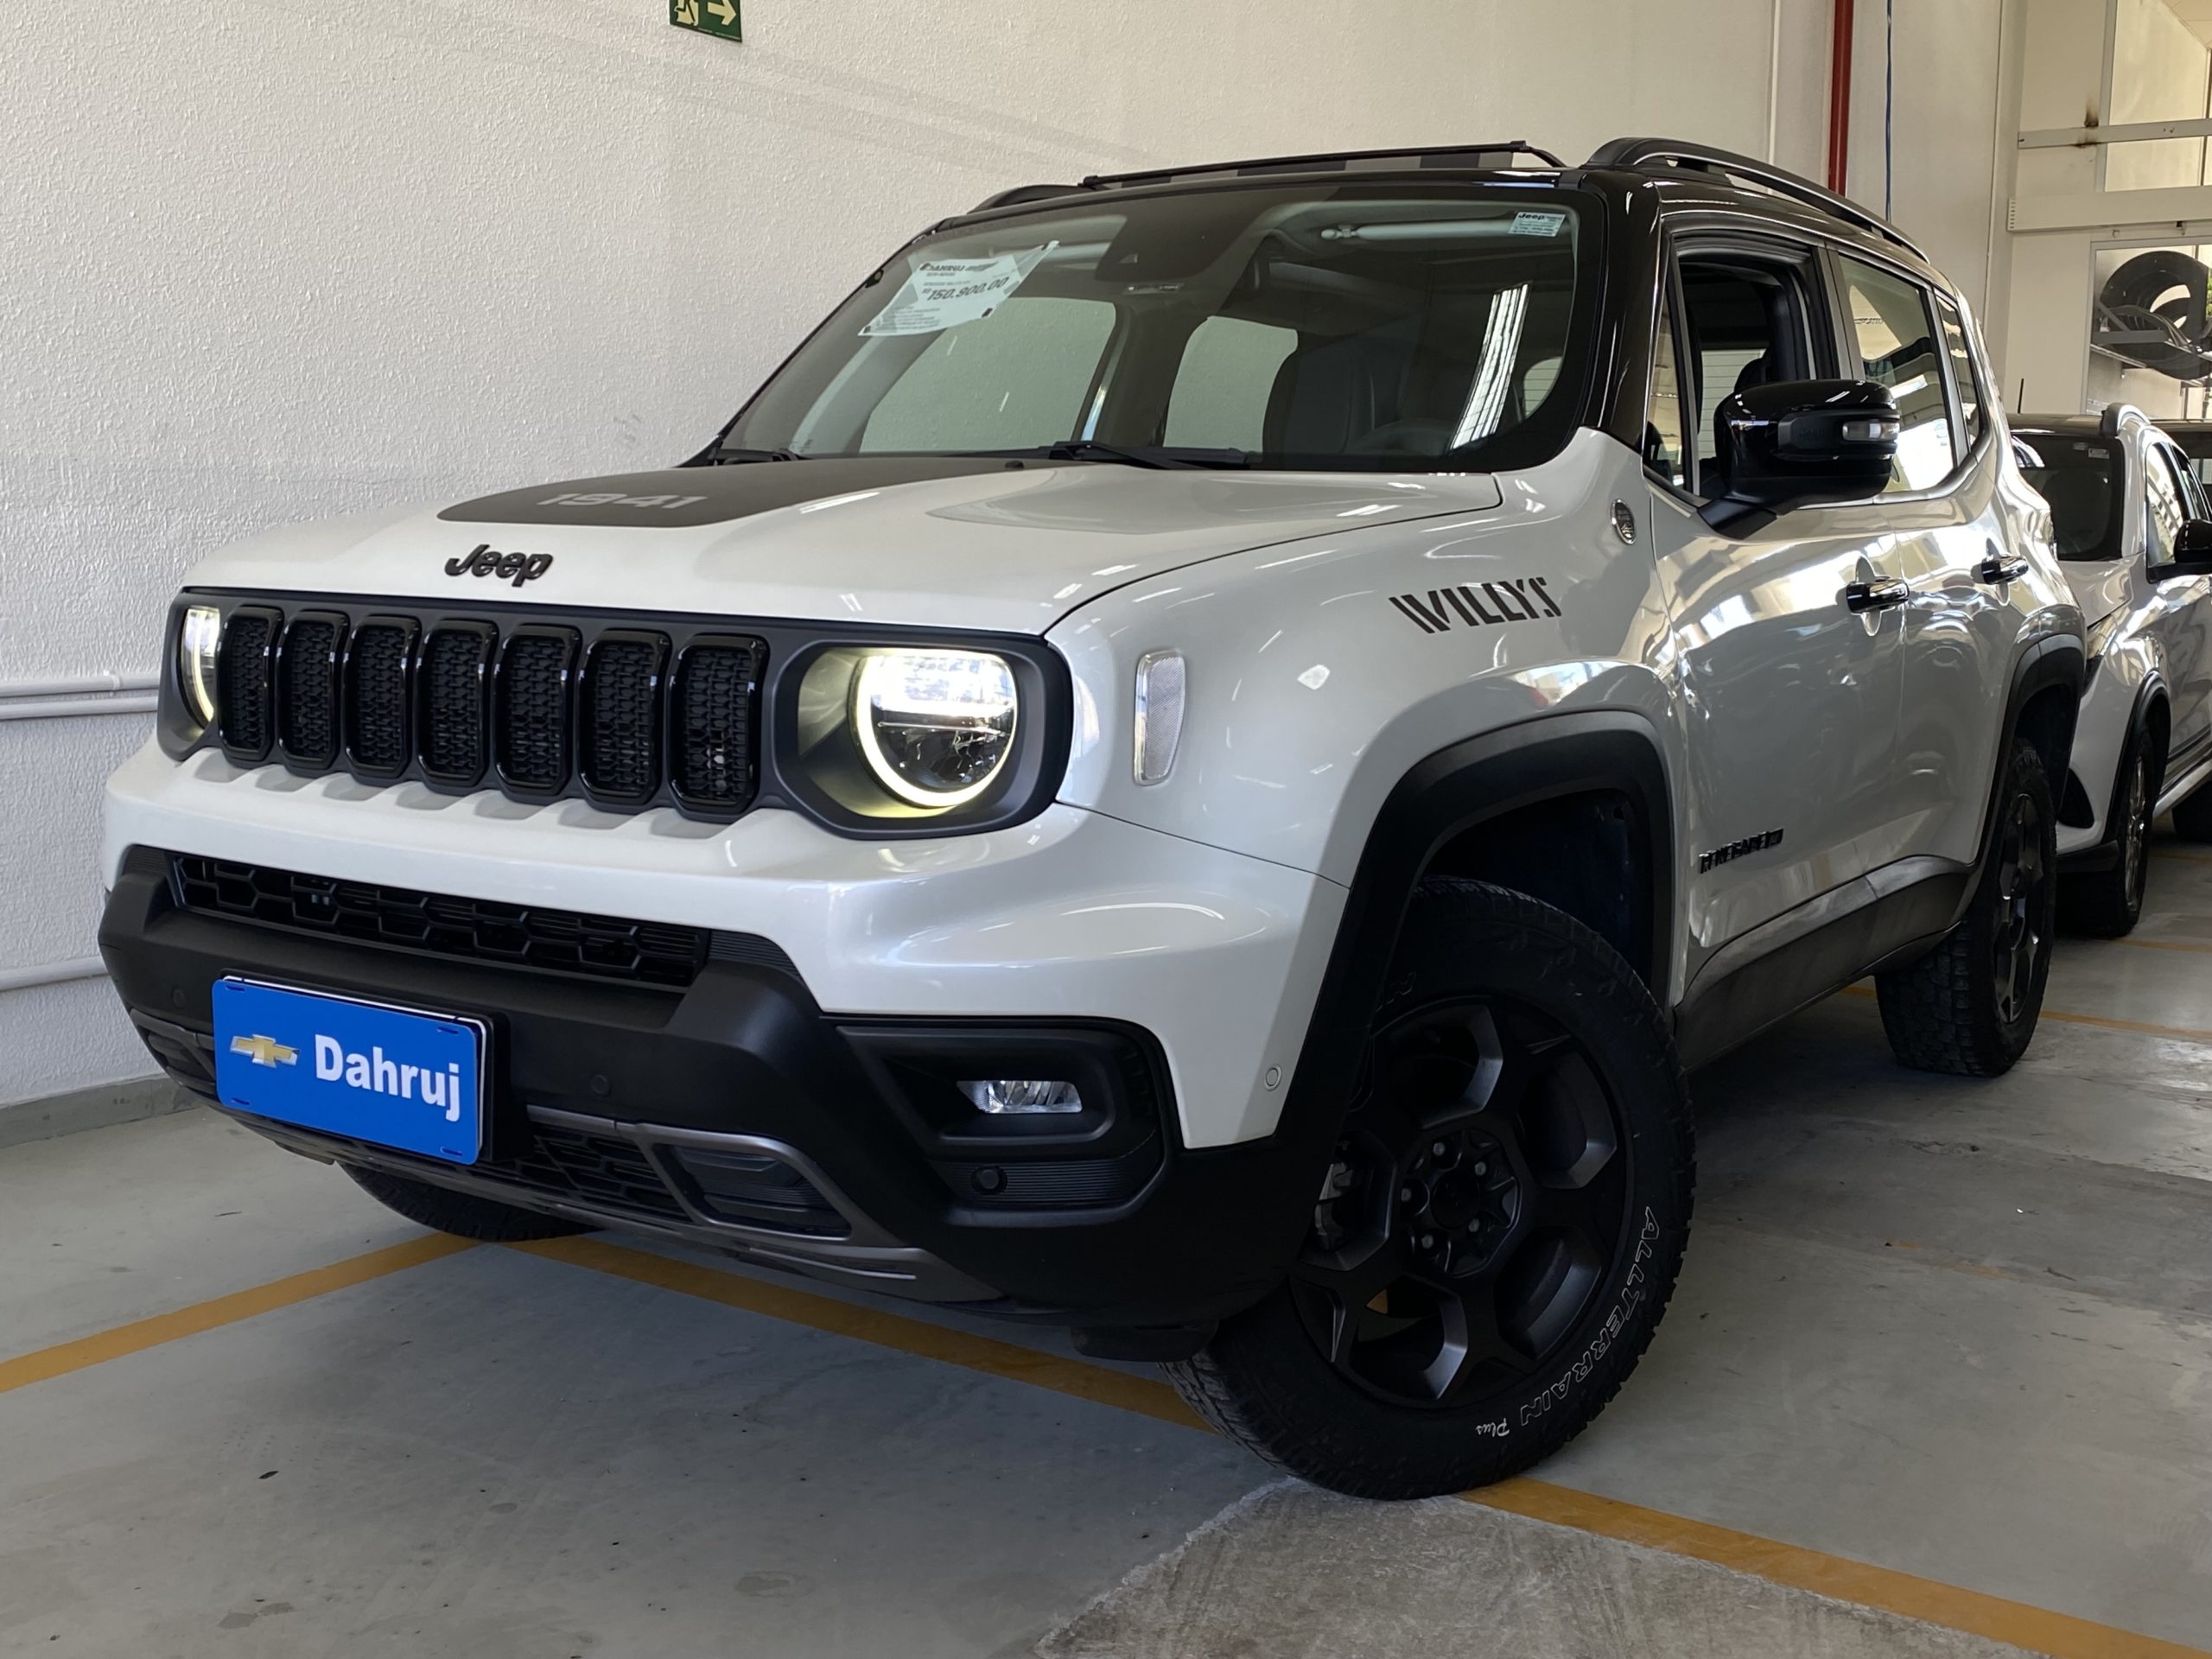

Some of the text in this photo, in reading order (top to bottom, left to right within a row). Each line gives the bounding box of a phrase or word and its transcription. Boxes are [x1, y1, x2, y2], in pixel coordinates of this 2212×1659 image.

[537, 493, 709, 509] 1941
[444, 543, 554, 588] Jeep
[1389, 576, 1562, 634] WILLYS
[315, 1033, 461, 1122] Dahruj
[1475, 1417, 1510, 1438] Plus
